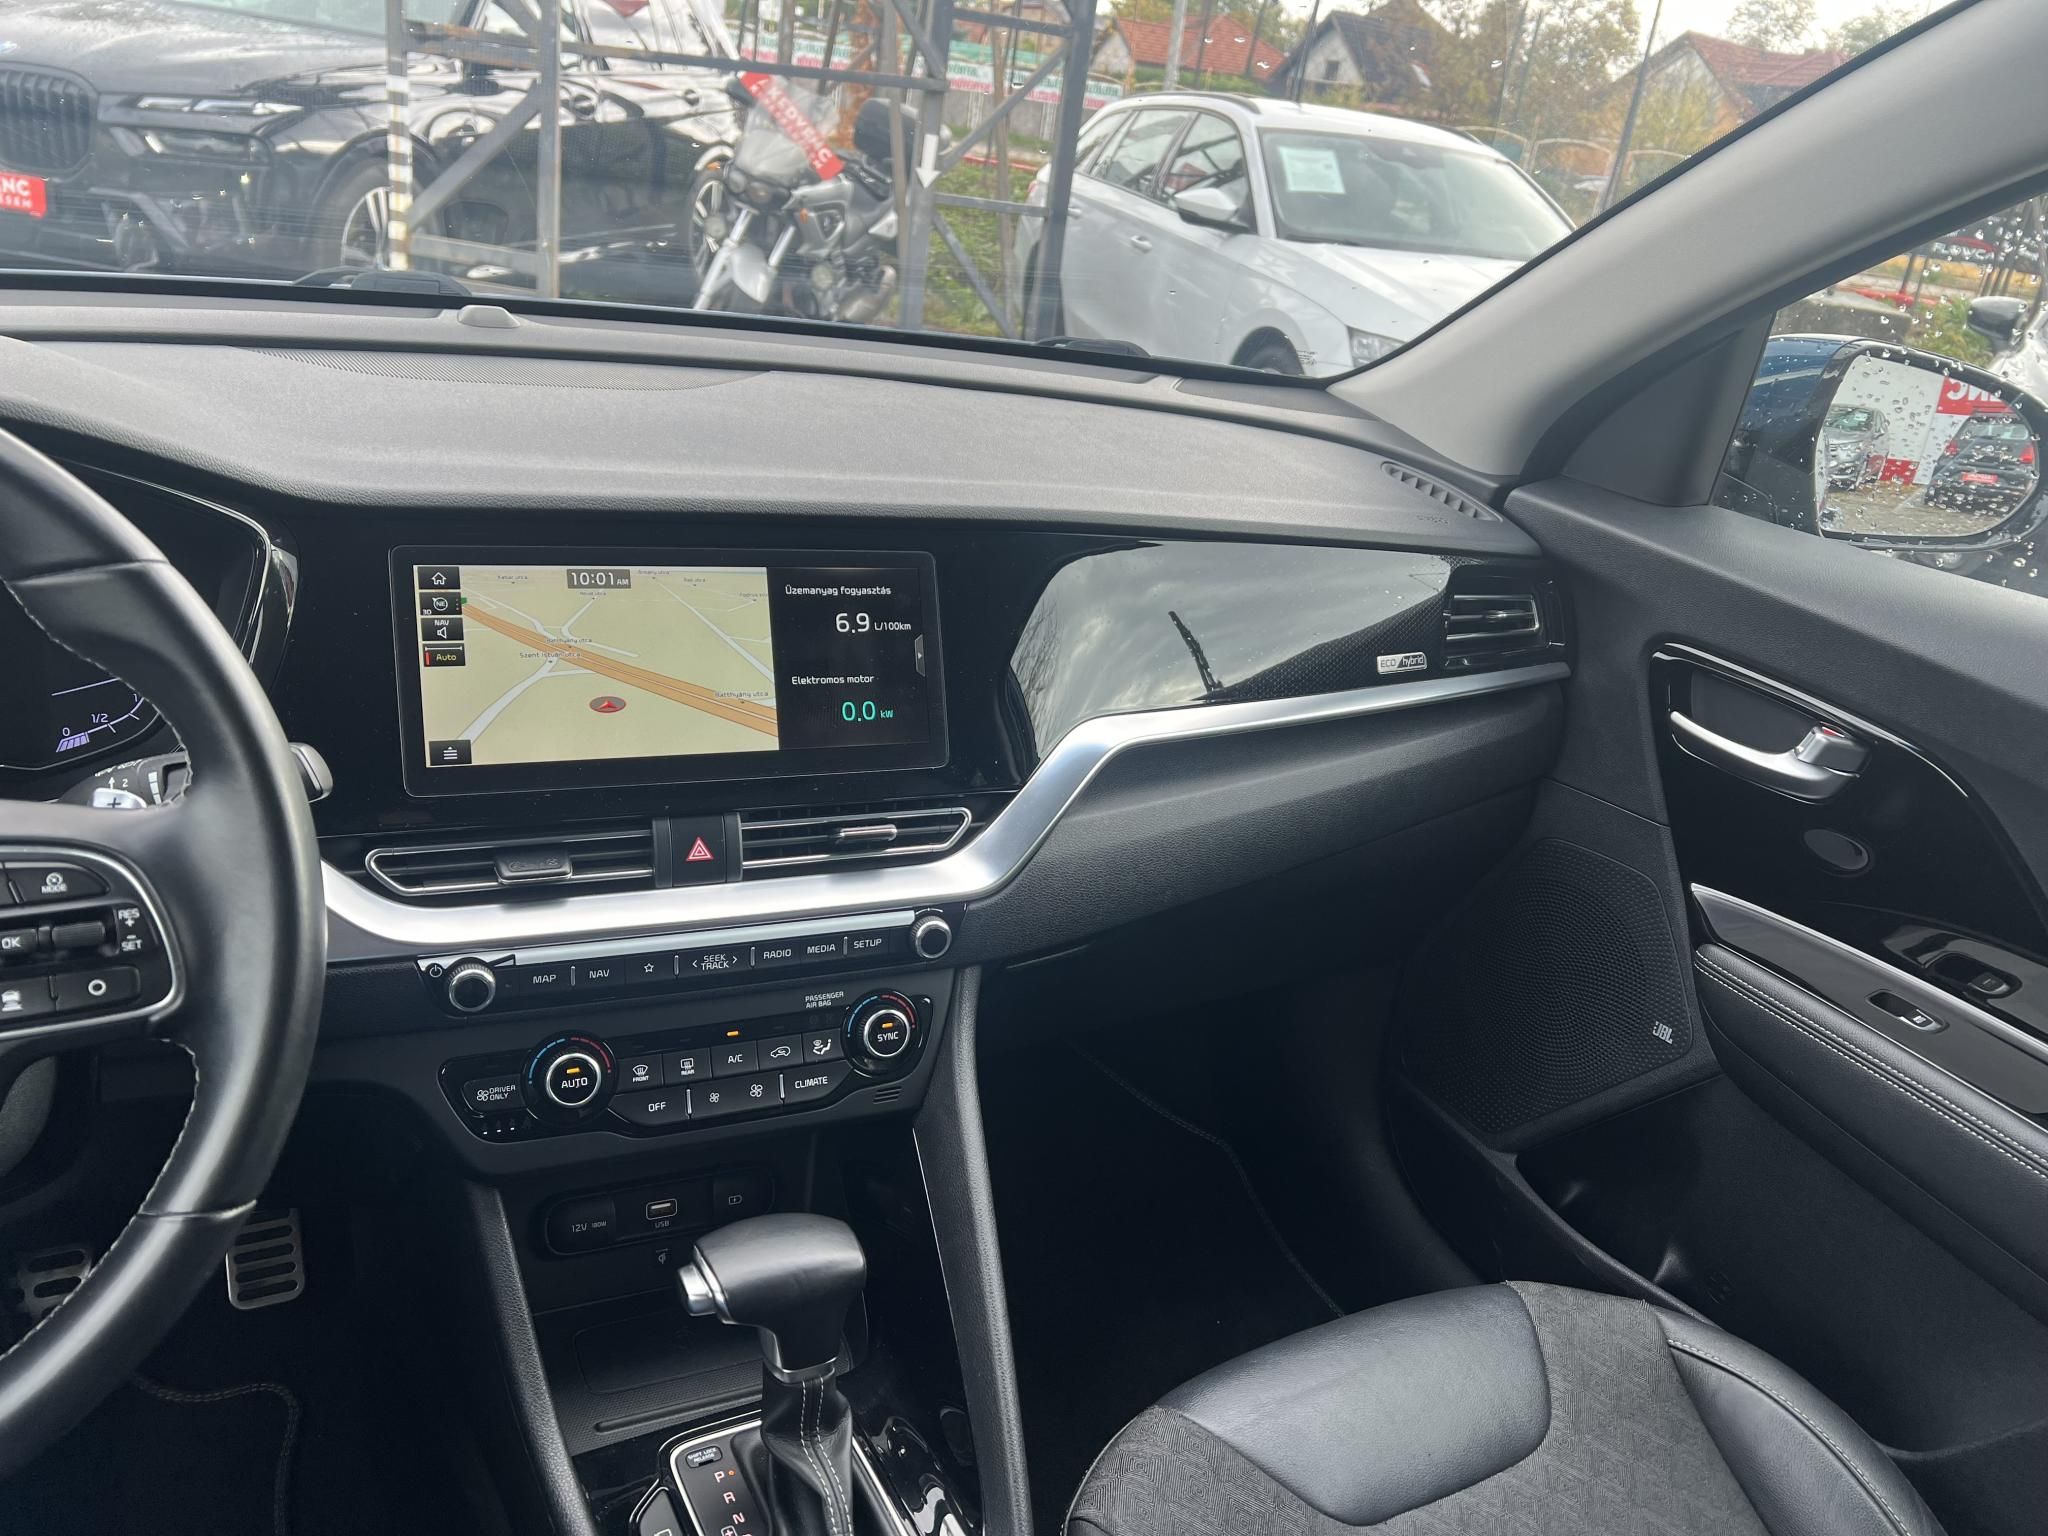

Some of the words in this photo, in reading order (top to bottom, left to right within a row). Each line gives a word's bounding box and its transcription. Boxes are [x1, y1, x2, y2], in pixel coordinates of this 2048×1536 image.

[0, 178, 31, 198] NC
[571, 572, 614, 586] 10:01
[617, 578, 629, 586] AM
[840, 585, 892, 596] fogyasztás
[422, 608, 433, 616] 3D
[835, 612, 870, 634] 6.9
[874, 621, 912, 631] L/100km
[436, 652, 457, 662] Auto
[1380, 659, 1396, 668] ECO
[1402, 655, 1424, 667] hybrid
[791, 676, 845, 685] Elektromos
[846, 675, 875, 684] motor
[841, 700, 877, 722] 0.0
[880, 710, 894, 719] kW
[91, 713, 109, 724] 1/2
[62, 727, 71, 737] 0
[41, 883, 68, 894] MODE
[118, 907, 140, 920] RES
[1, 936, 21, 949] OK
[121, 939, 143, 951] SET
[853, 938, 882, 949] SETUP
[763, 949, 792, 960] RADIO
[806, 943, 836, 955] MEDIA
[703, 953, 727, 964] SEEK
[700, 960, 730, 972] TRACK
[589, 968, 611, 979] NAV
[532, 974, 557, 985] MAP
[805, 991, 844, 1003] PASSENGER
[805, 1001, 818, 1009] AIR
[818, 1000, 832, 1008] BAG
[877, 1031, 899, 1042] SYNC
[1652, 1020, 1673, 1045] JBL
[727, 1053, 744, 1065] A/C
[561, 1077, 589, 1089] AUTO
[632, 1075, 650, 1083] FRONT
[794, 1076, 829, 1089] CLIMATE
[489, 1084, 516, 1095] DRIVER
[489, 1092, 510, 1101] ONLY
[648, 1102, 667, 1112] OFF
[571, 1223, 588, 1233] 12V
[654, 1220, 670, 1229] USB
[703, 1447, 718, 1456] LOCK
[714, 1471, 725, 1483] P
[723, 1491, 736, 1504] R
[732, 1512, 745, 1525] N
